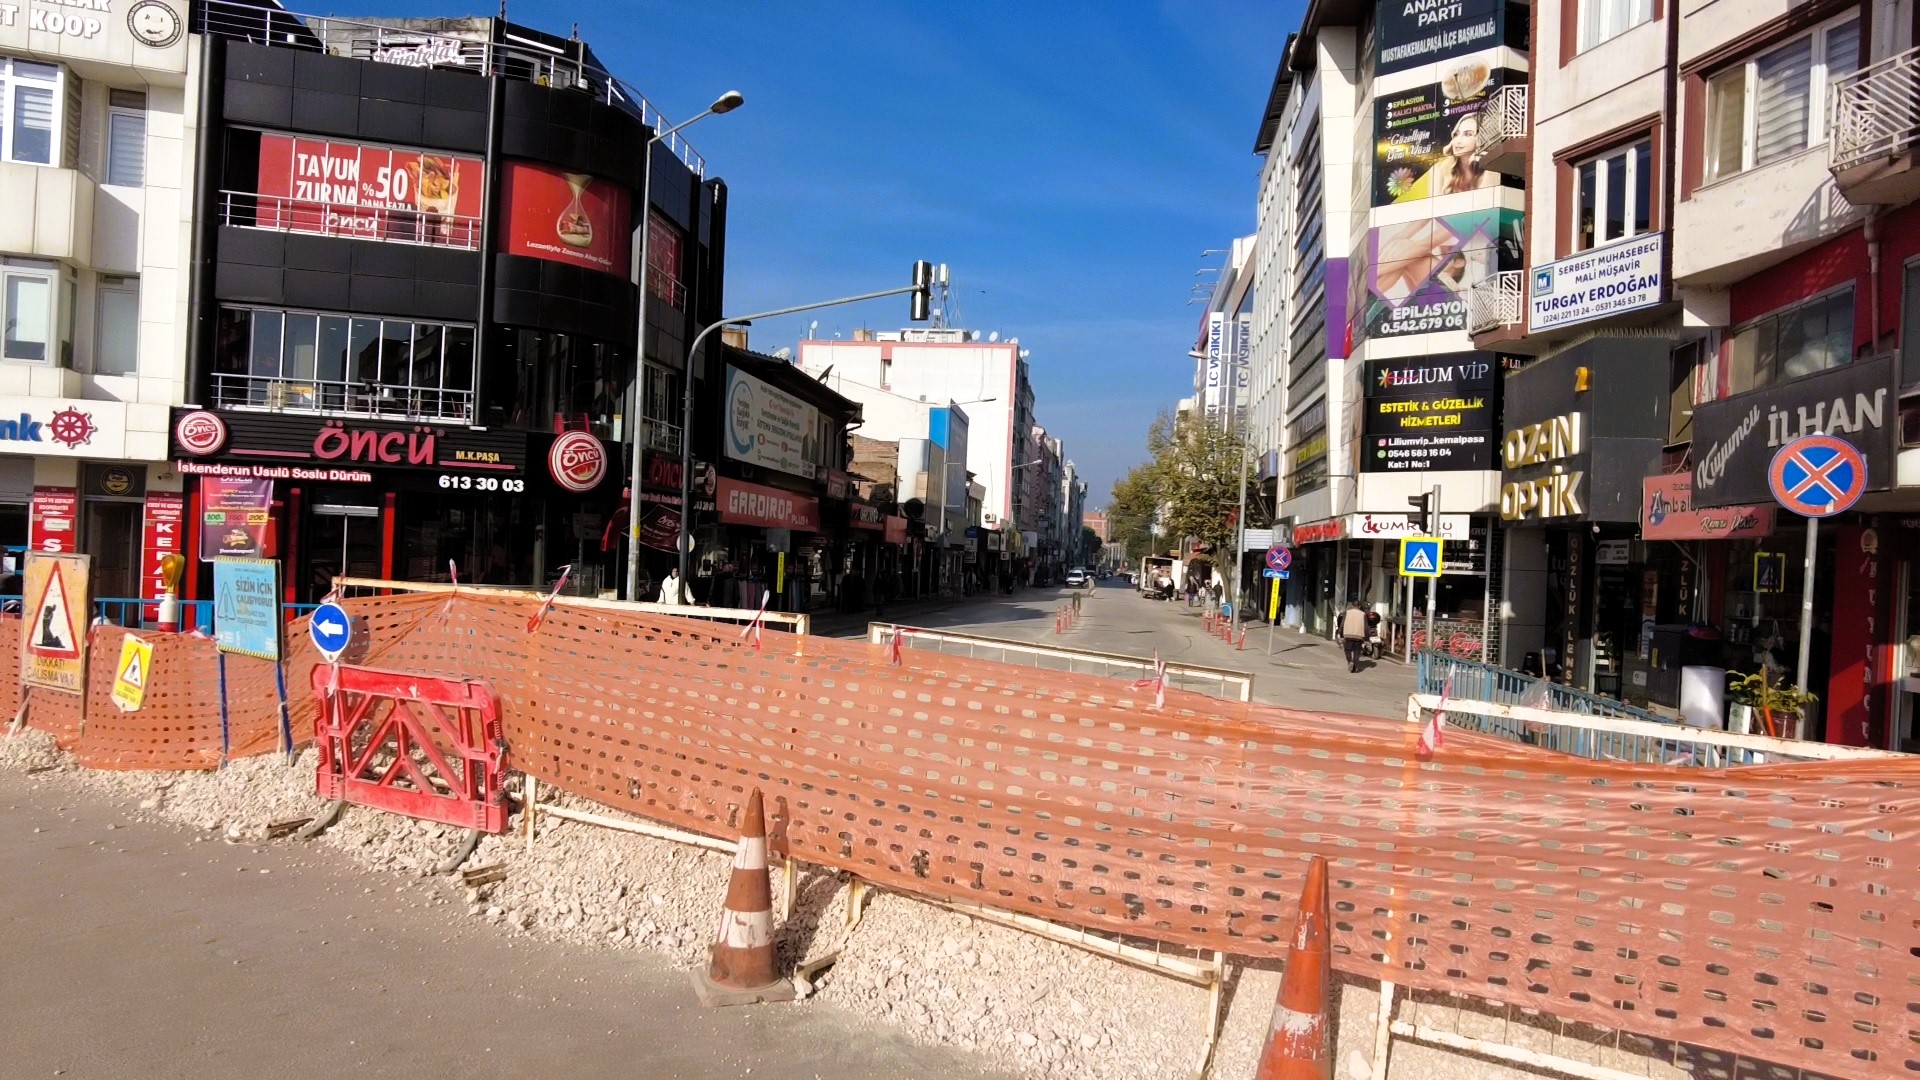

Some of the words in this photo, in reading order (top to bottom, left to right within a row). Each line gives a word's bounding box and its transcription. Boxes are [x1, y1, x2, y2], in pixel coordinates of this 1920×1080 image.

[30, 8, 101, 39] KOOP
[1418, 3, 1462, 27] PARTİ
[1443, 30, 1457, 49] İLÇE
[298, 154, 359, 181] TAVUK
[296, 181, 358, 205] ZURNA
[1558, 259, 1595, 276] SERBEST
[1598, 238, 1659, 265] MUHASEBECİ
[1575, 269, 1596, 285] MALİ
[1599, 258, 1640, 279] MÜŞAVİR
[1535, 291, 1586, 314] TURGAY
[1589, 274, 1658, 301] ERDOĞAN
[1560, 310, 1572, 320] 221
[1573, 309, 1580, 317] 13
[1581, 307, 1590, 316] 24
[1595, 302, 1612, 312] 0531
[1613, 299, 1626, 308] 345
[1627, 296, 1637, 305] 53
[1445, 315, 1463, 328] 06
[1379, 400, 1419, 413] ESTETİK
[1422, 402, 1429, 411] &
[1432, 396, 1484, 411] GÜZELLİK
[1400, 414, 1461, 427] HİZMETLERİ
[1767, 387, 1888, 448] İLHAN
[1504, 412, 1581, 469] OZAN
[1697, 404, 1761, 490] Kuyumcu
[455, 450, 500, 464] M.K.PAŞA
[177, 461, 250, 476] İskenderun
[292, 468, 325, 480] Soslu
[329, 470, 372, 482] Dürüm
[438, 474, 471, 489] 613
[476, 478, 498, 491] 30
[502, 479, 525, 492] 03
[1502, 465, 1583, 521] OPTİK
[1565, 630, 1574, 680] LENS
